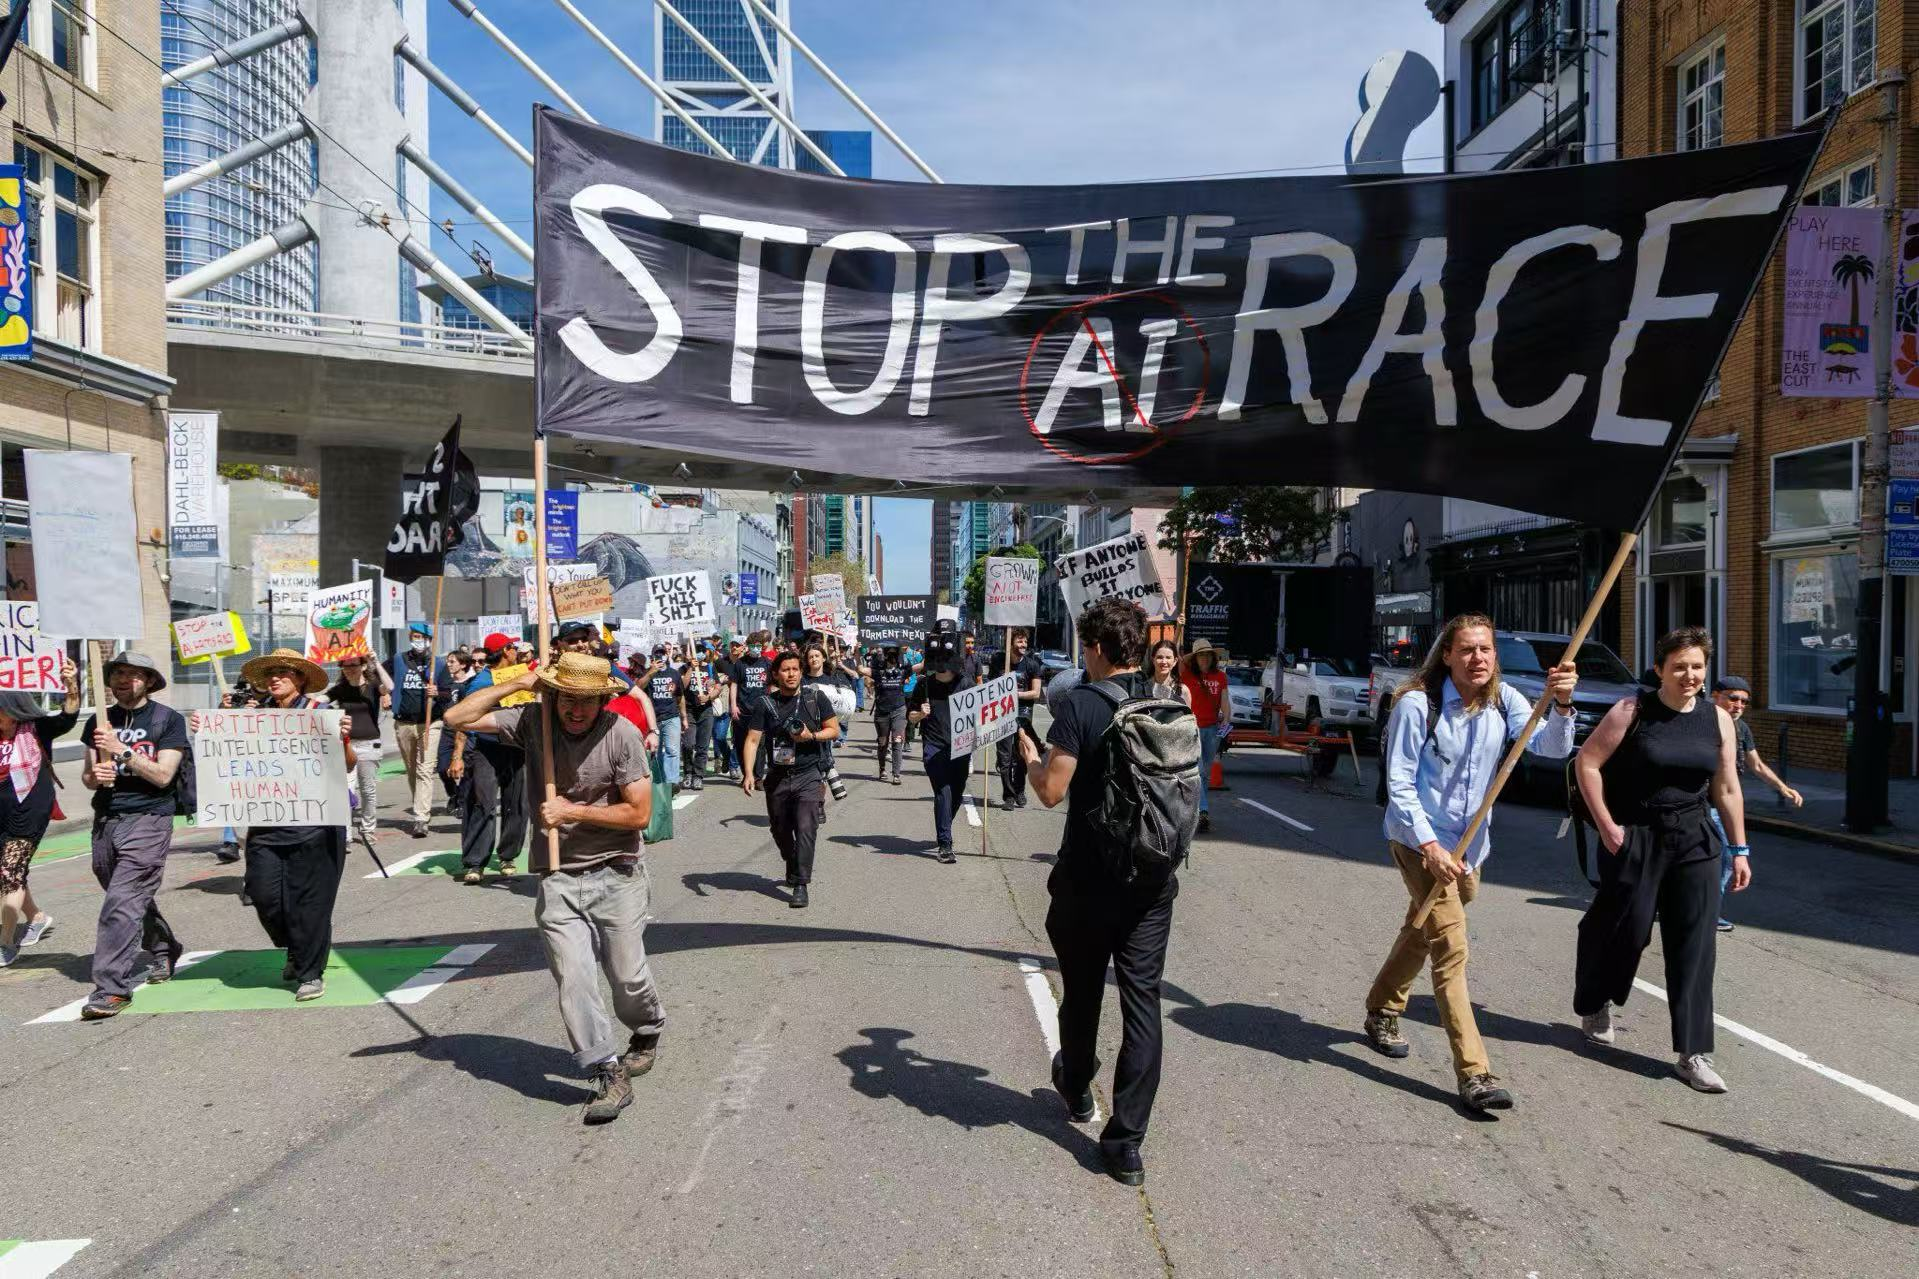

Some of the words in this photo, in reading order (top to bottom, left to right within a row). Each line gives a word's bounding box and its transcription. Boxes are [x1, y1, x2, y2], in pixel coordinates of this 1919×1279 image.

[1790, 216, 1829, 233] PLAY
[1045, 215, 1235, 287] THE
[1819, 236, 1862, 252] HERE
[557, 183, 1032, 417] STOP
[1217, 185, 1788, 447] RACE
[1785, 351, 1809, 362] THE
[1033, 316, 1179, 434] AI
[1784, 363, 1818, 375] EAST
[1783, 376, 1811, 388] CUT
[174, 421, 190, 523] DAHL-BECK
[190, 419, 206, 522] WAREHOUSE
[173, 526, 190, 534] FOR
[192, 526, 217, 534] LEASE
[1058, 556, 1078, 580] IF
[1084, 536, 1147, 570] ANYONE
[651, 576, 697, 594] FUCK
[992, 580, 1022, 594] NOT
[1099, 579, 1117, 596] IT
[272, 592, 308, 603] SPEE
[313, 588, 370, 609] HUMANITY
[654, 591, 696, 607] THIS
[801, 598, 815, 606] We
[865, 600, 881, 612] YOU
[885, 600, 926, 612] WOULDN'T
[660, 601, 706, 624] SHIT
[1190, 605, 1229, 613] TRAFFIC
[864, 614, 904, 624] DOWNLOAD
[909, 615, 924, 624] THE
[328, 630, 355, 649] AI
[860, 629, 900, 640] TORMENT
[902, 629, 931, 641] NEXU
[953, 685, 995, 712] VOTE
[997, 676, 1014, 695] NO
[954, 713, 975, 734] ON
[981, 694, 1016, 726] FISA
[202, 713, 332, 736] ARTIFICIAL
[202, 738, 329, 758] INTELLIGENCE
[217, 759, 284, 778] LEADS
[297, 757, 321, 777] TO
[230, 782, 298, 799] HUMAN
[204, 799, 327, 822] STUPIDITY
